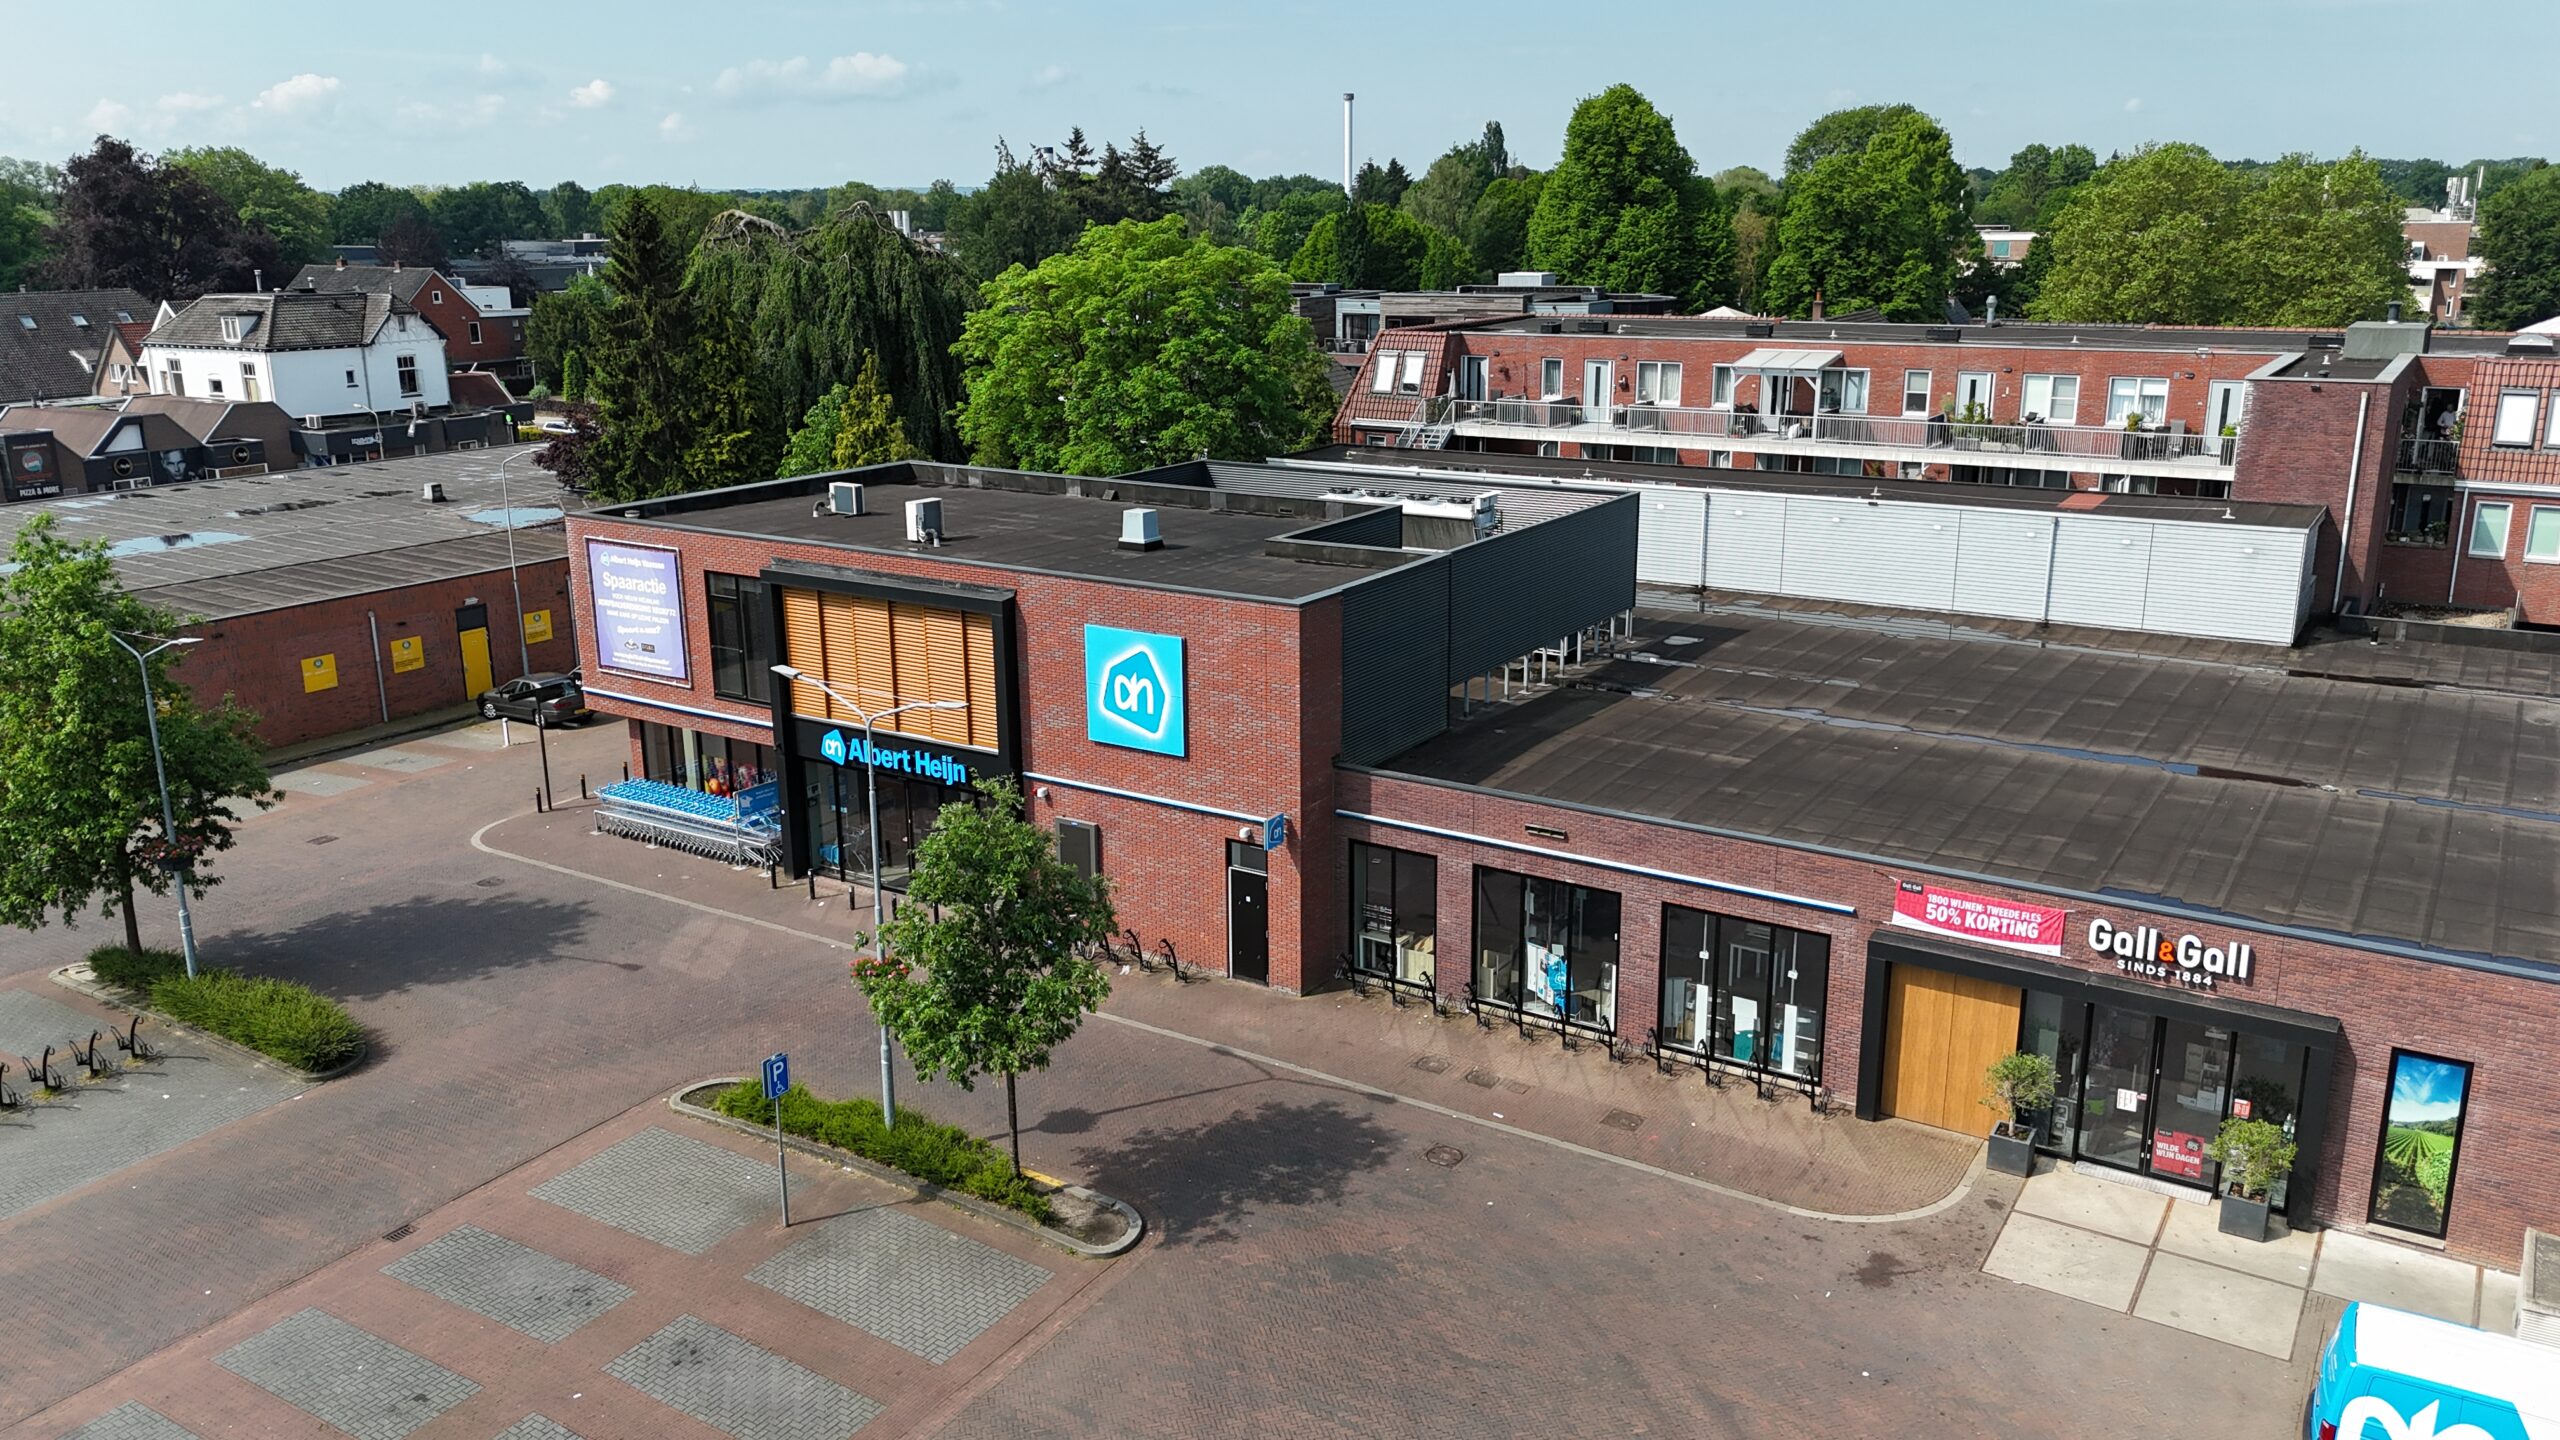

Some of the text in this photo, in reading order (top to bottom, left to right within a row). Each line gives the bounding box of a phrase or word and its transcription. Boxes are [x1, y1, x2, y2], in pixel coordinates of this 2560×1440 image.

[602, 571, 667, 595] Spaaractie
[848, 737, 911, 773] Albert
[914, 750, 967, 786] Heijn
[1927, 893, 1949, 906] 1800
[1950, 898, 1985, 912] WIJNEN:
[1986, 904, 2021, 919] TWEEDE
[2021, 911, 2042, 922] FLES
[1926, 903, 2040, 939] 50% KORTING
[2116, 959, 2212, 986] SINDS 1884
[772, 1061, 784, 1082] P
[2156, 1141, 2180, 1152] WILDE
[2156, 1149, 2200, 1165] WIJN DAGEN
